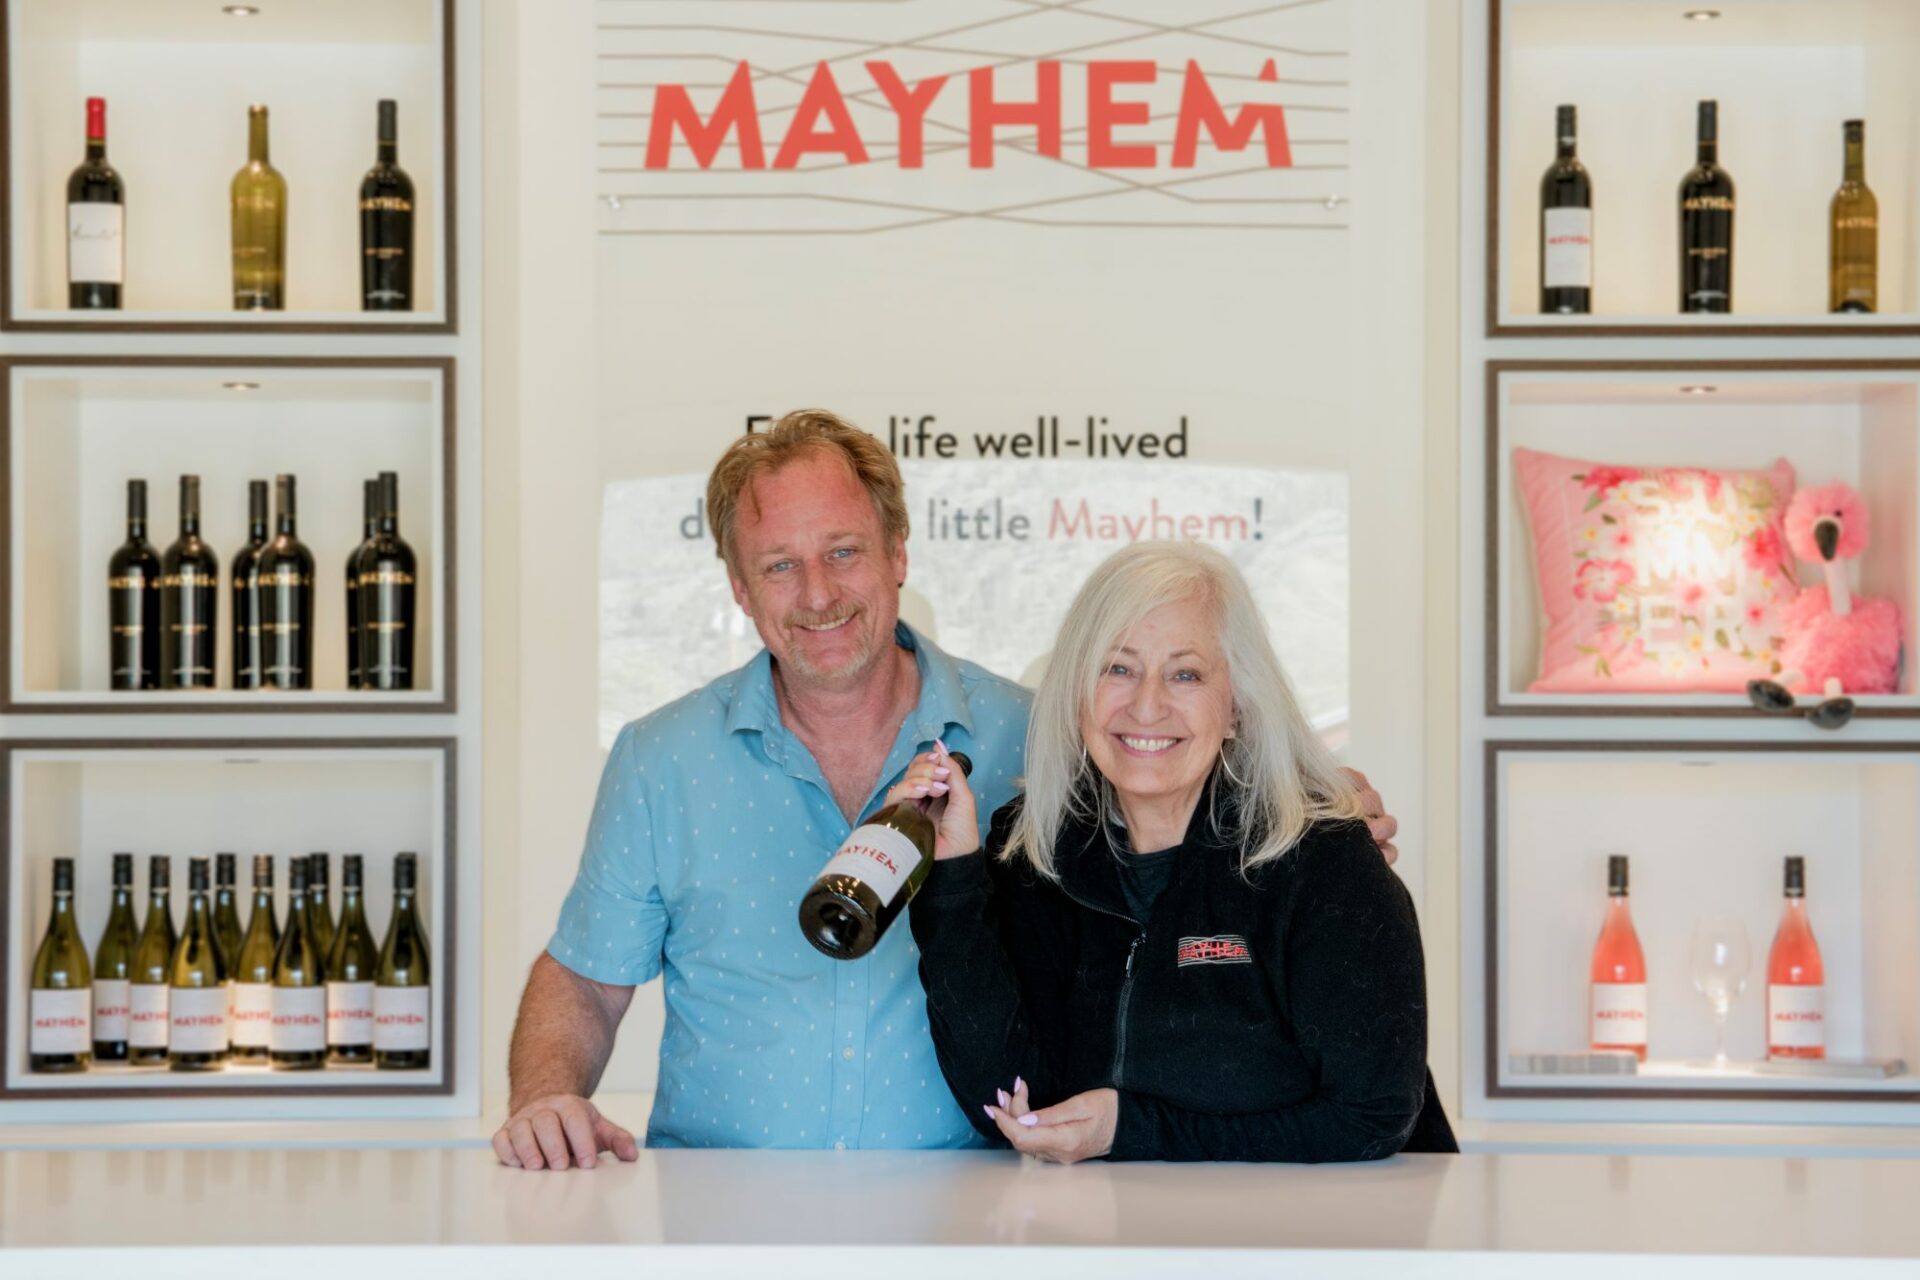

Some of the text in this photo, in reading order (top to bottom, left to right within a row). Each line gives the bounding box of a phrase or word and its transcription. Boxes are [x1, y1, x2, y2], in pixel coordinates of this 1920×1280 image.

[644, 58, 1293, 169] MAYHEM
[890, 415, 1188, 458] life well-lived
[927, 498, 1263, 541] little Mayhem!
